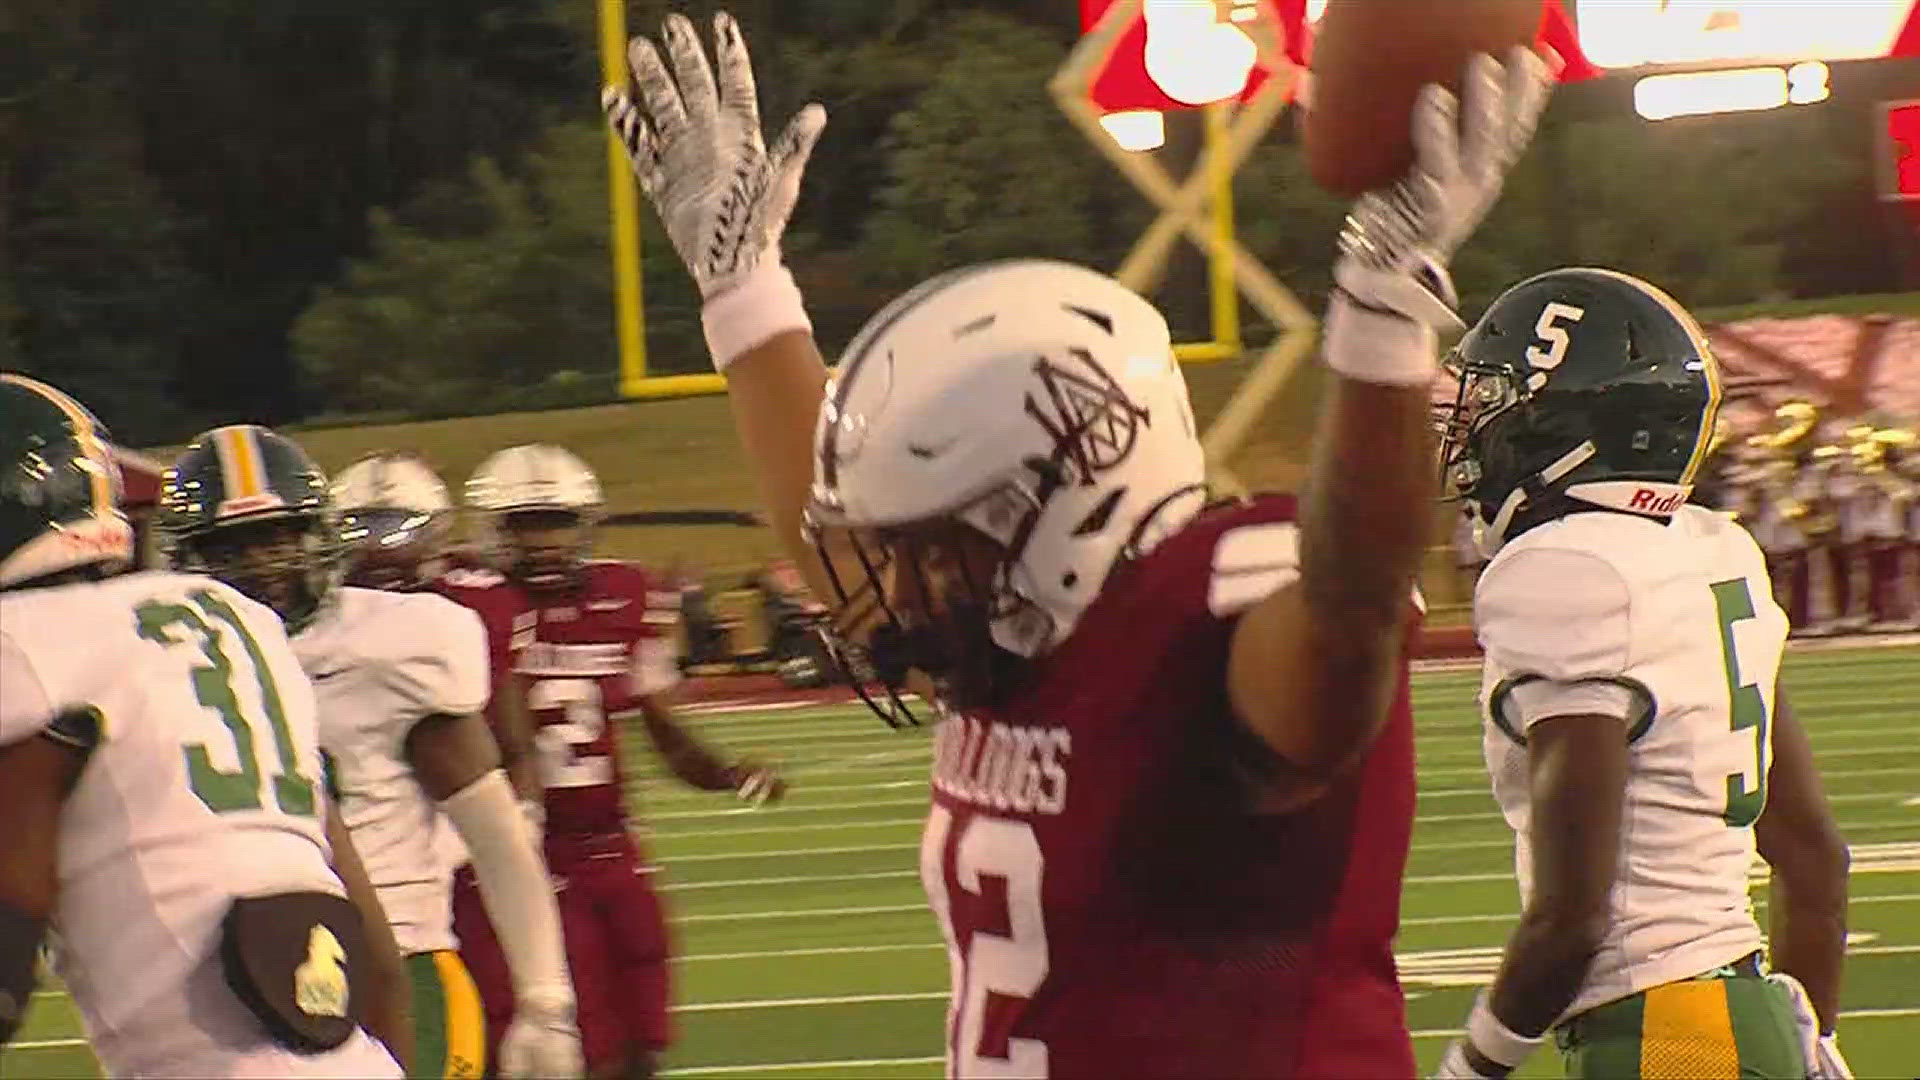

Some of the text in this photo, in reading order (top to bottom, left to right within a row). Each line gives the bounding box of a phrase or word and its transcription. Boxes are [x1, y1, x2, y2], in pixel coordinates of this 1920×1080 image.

[1525, 301, 1585, 370] 5
[135, 587, 316, 816] 31
[527, 678, 615, 788] 2
[1709, 576, 1766, 828] 5
